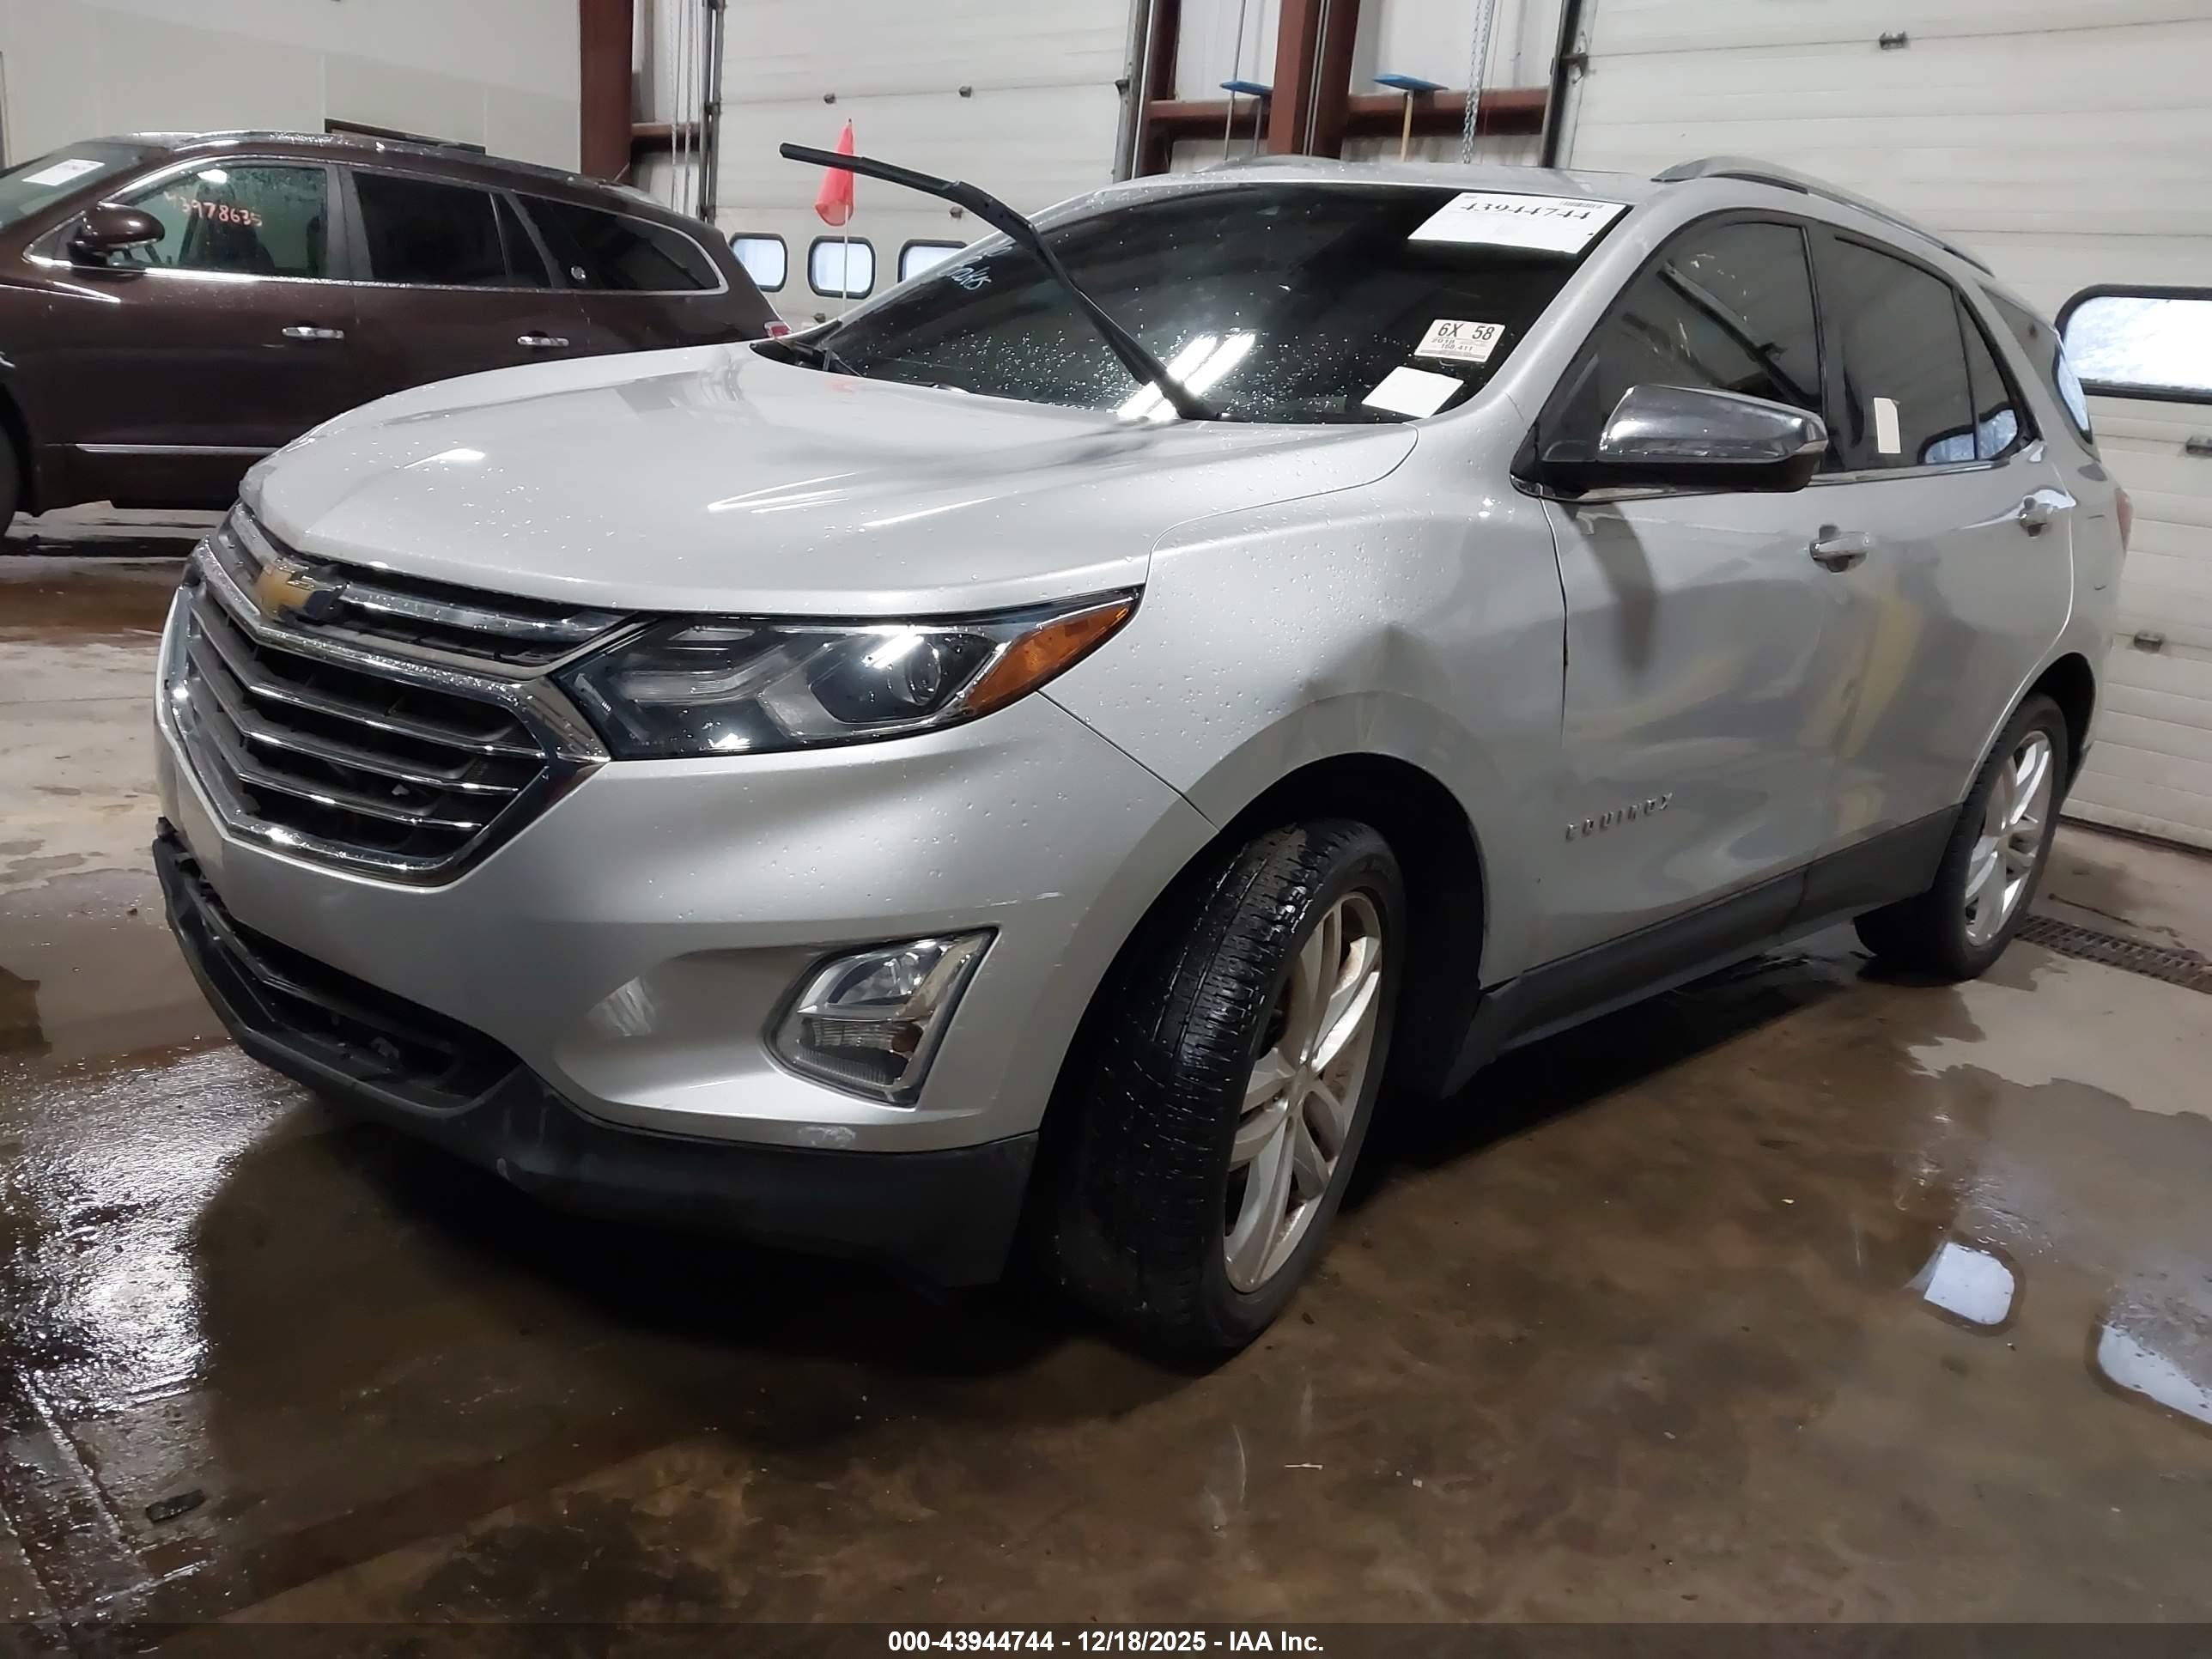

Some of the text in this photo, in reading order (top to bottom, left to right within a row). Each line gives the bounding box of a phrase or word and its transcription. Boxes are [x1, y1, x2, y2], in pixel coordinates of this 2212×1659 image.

[163, 191, 263, 227] 43978635
[1460, 202, 1592, 220] 43944744
[1437, 322, 1496, 341] 6X 58
[1565, 791, 1674, 842] EQUINOX
